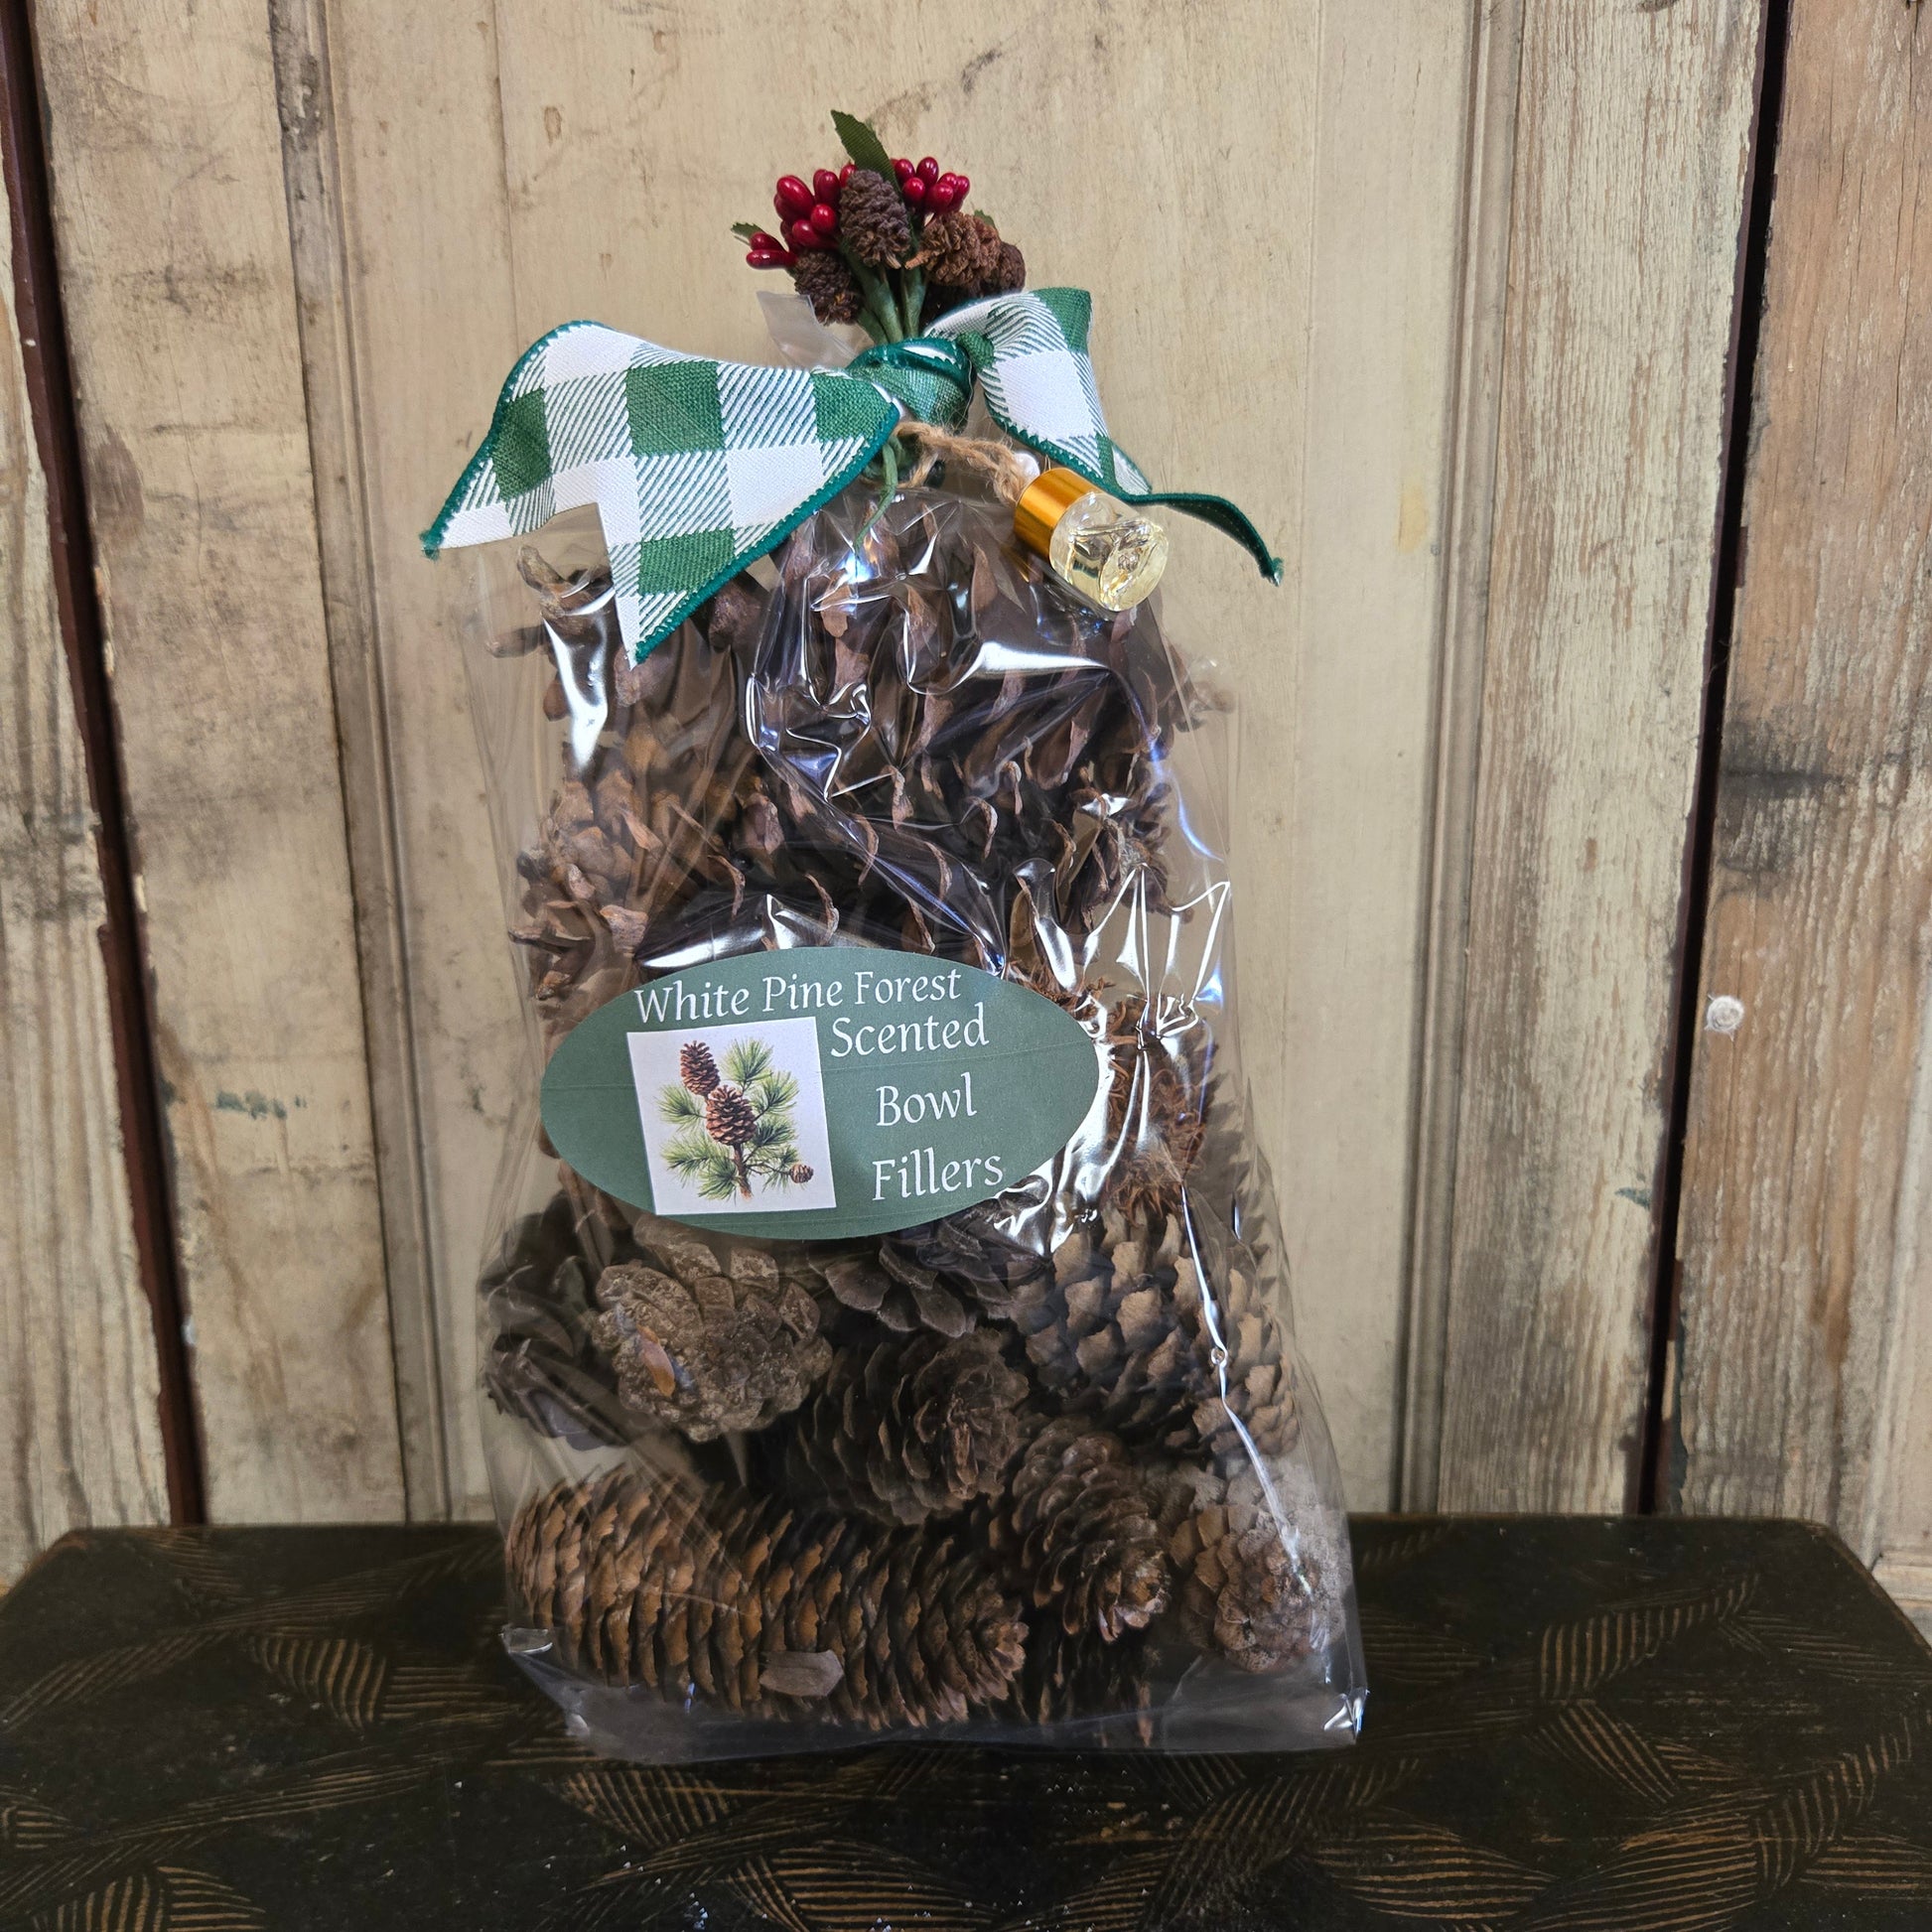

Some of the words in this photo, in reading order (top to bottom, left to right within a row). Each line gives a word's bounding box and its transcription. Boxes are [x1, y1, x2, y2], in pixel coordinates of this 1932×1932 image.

[633, 978, 751, 1025] White
[761, 972, 844, 1013] Pine
[854, 967, 962, 1005] Forest
[830, 1001, 990, 1058] Scented
[876, 1072, 978, 1128] Bowl
[872, 1147, 1005, 1202] Fillers
